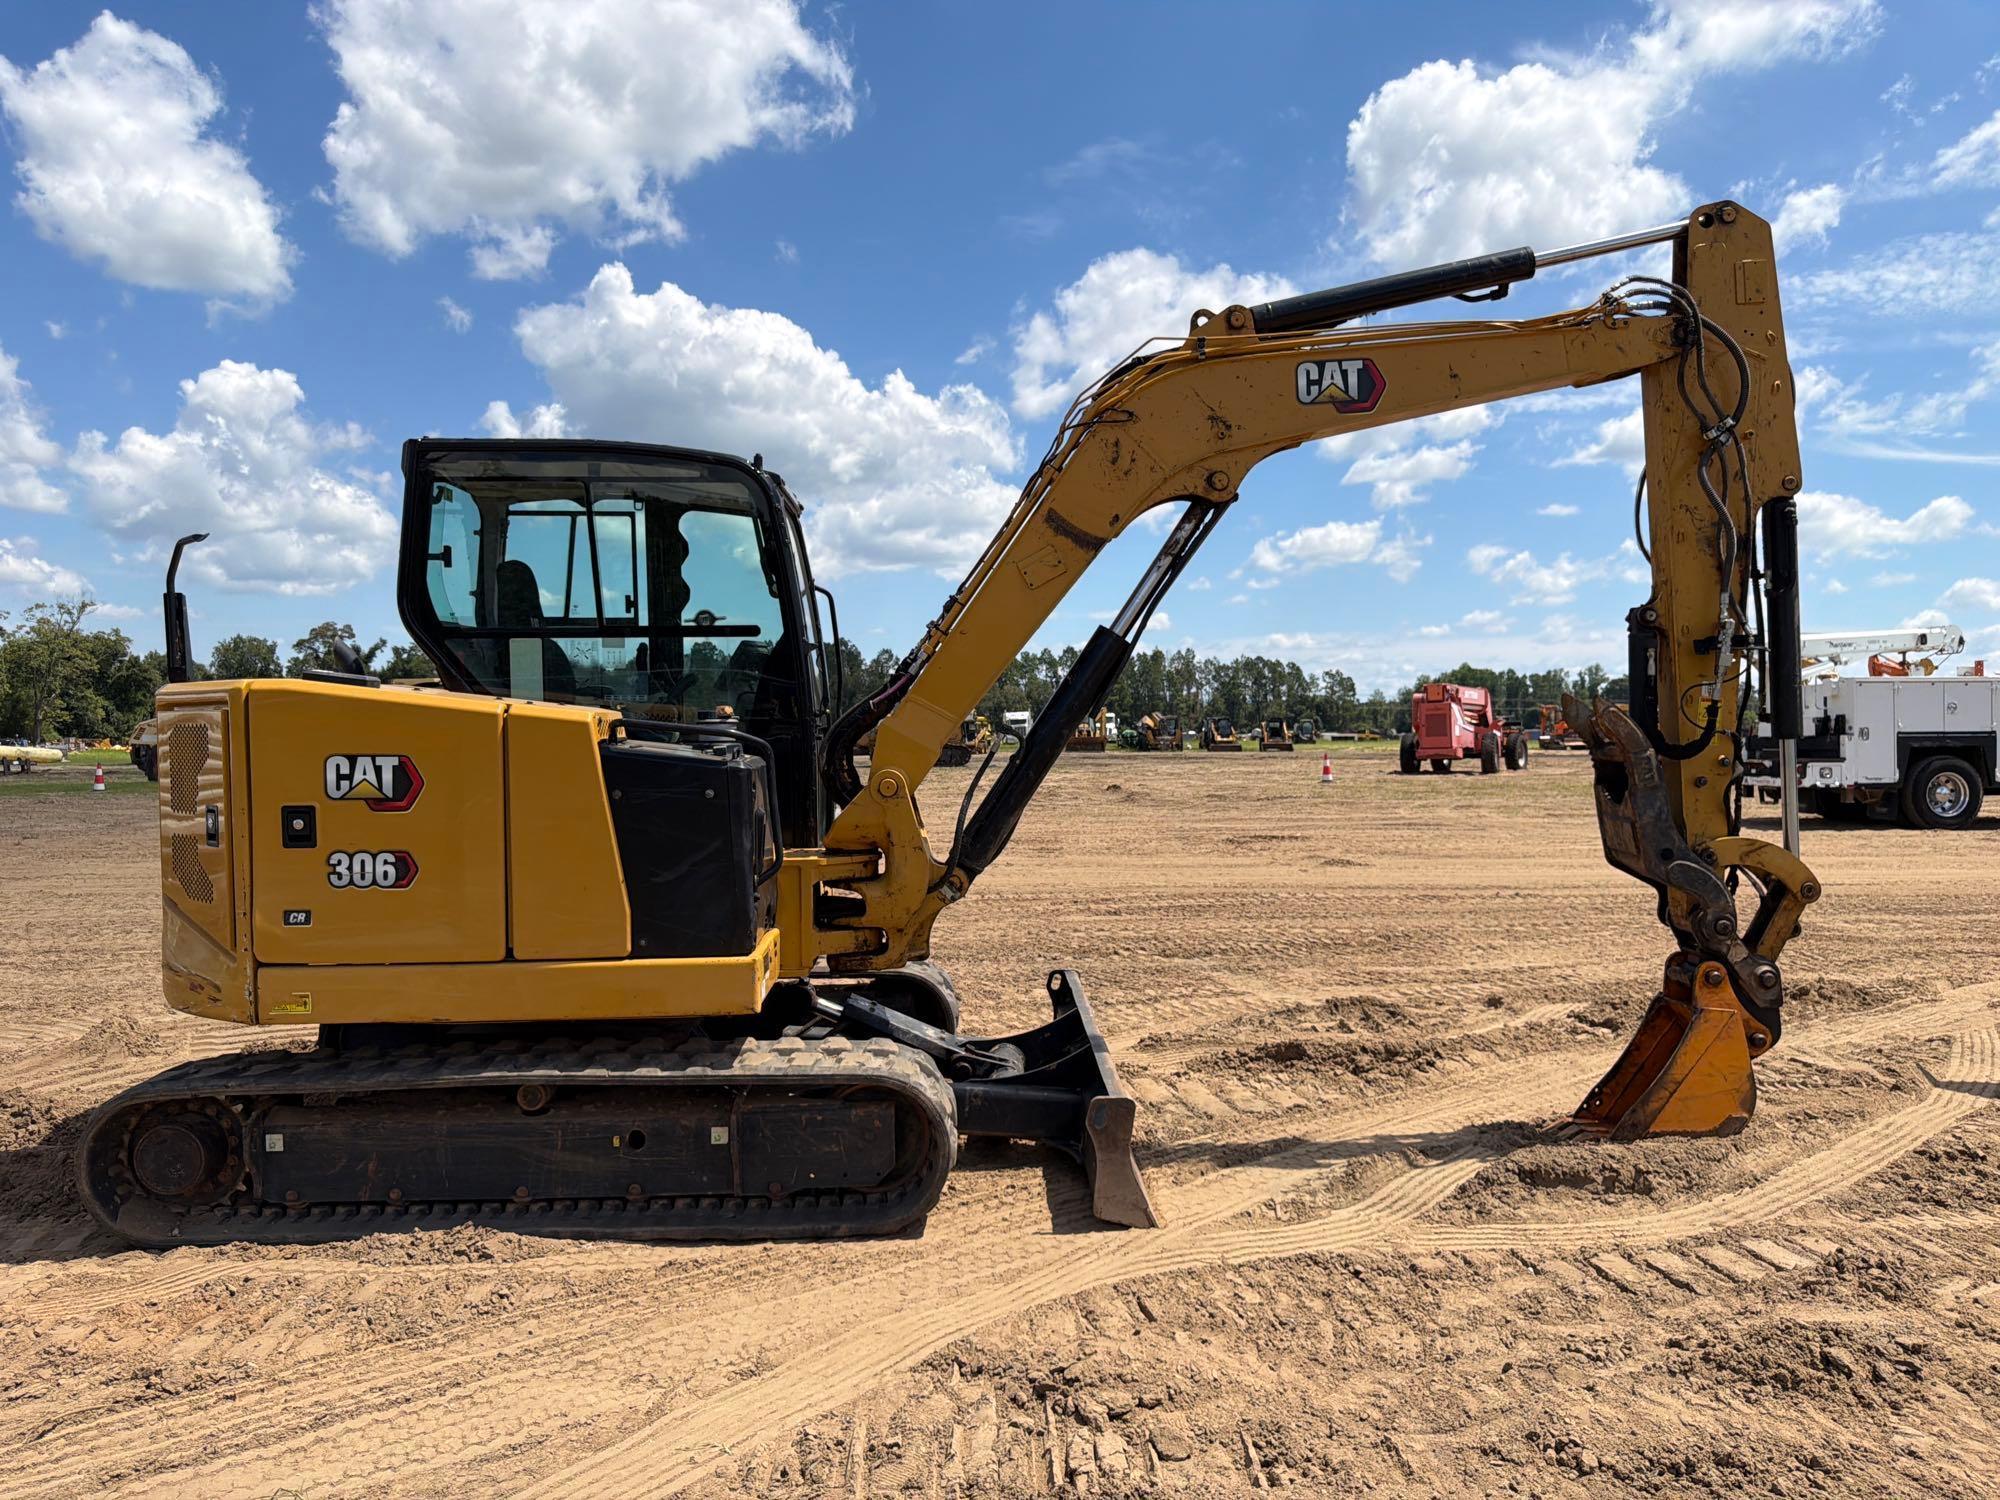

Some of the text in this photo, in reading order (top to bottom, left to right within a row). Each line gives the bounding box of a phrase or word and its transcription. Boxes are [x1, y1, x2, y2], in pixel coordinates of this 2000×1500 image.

[1297, 360, 1363, 403] CAT
[326, 755, 399, 799] CAT
[329, 852, 396, 888] 306
[289, 912, 306, 924] CR
